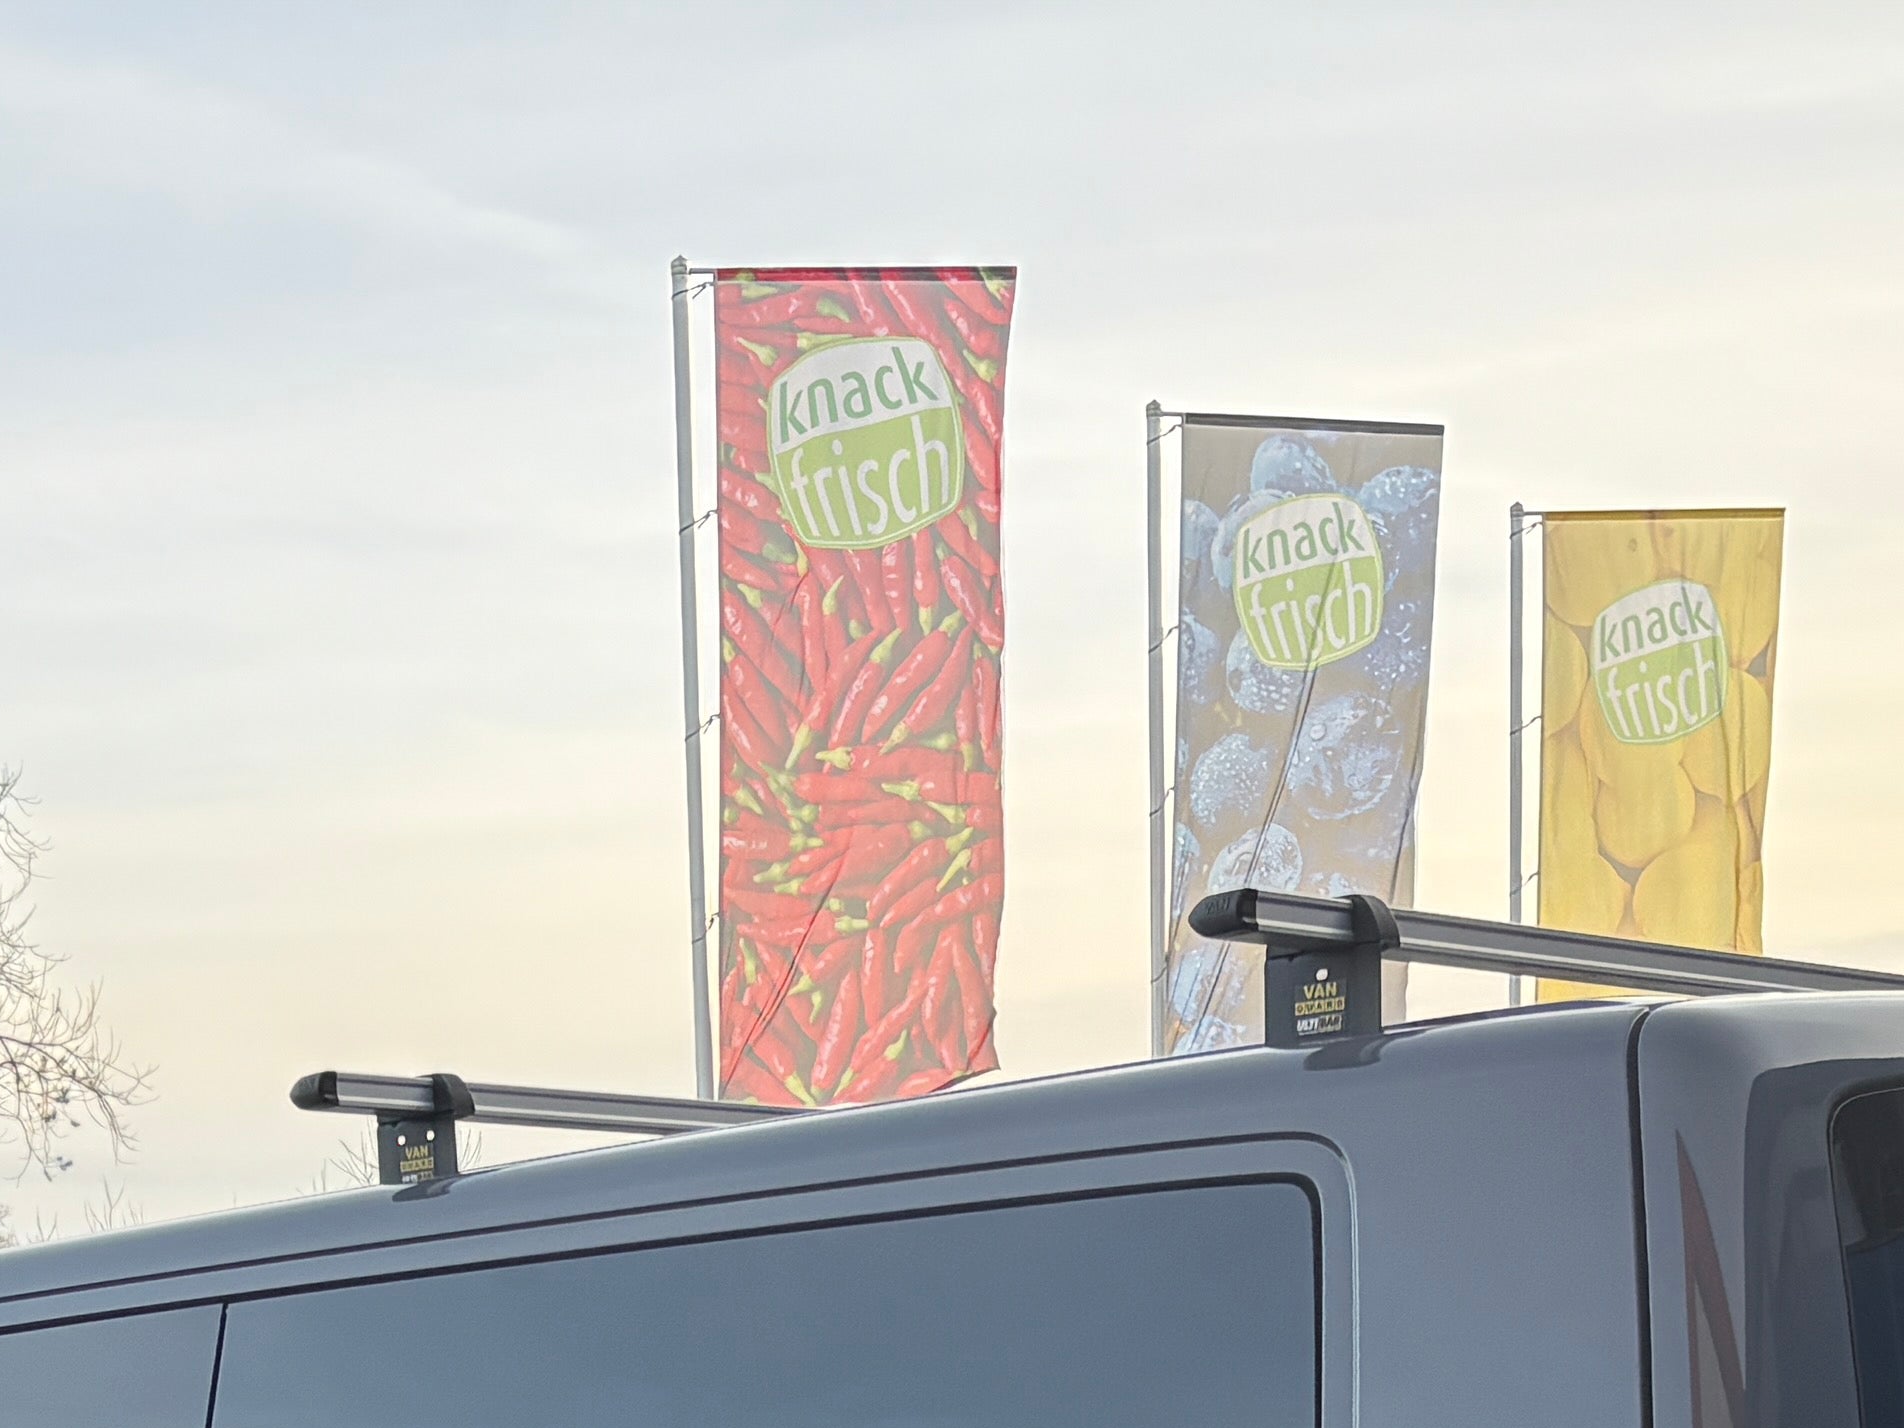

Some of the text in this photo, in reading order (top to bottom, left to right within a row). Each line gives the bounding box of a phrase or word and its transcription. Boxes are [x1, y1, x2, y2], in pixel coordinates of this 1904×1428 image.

[777, 346, 939, 444] knack
[789, 413, 951, 537] frisch
[1241, 502, 1365, 575] knack
[1247, 562, 1373, 661] frisch
[1598, 587, 1712, 658] knack
[1605, 641, 1716, 739] frisch
[1304, 982, 1336, 999] VAN
